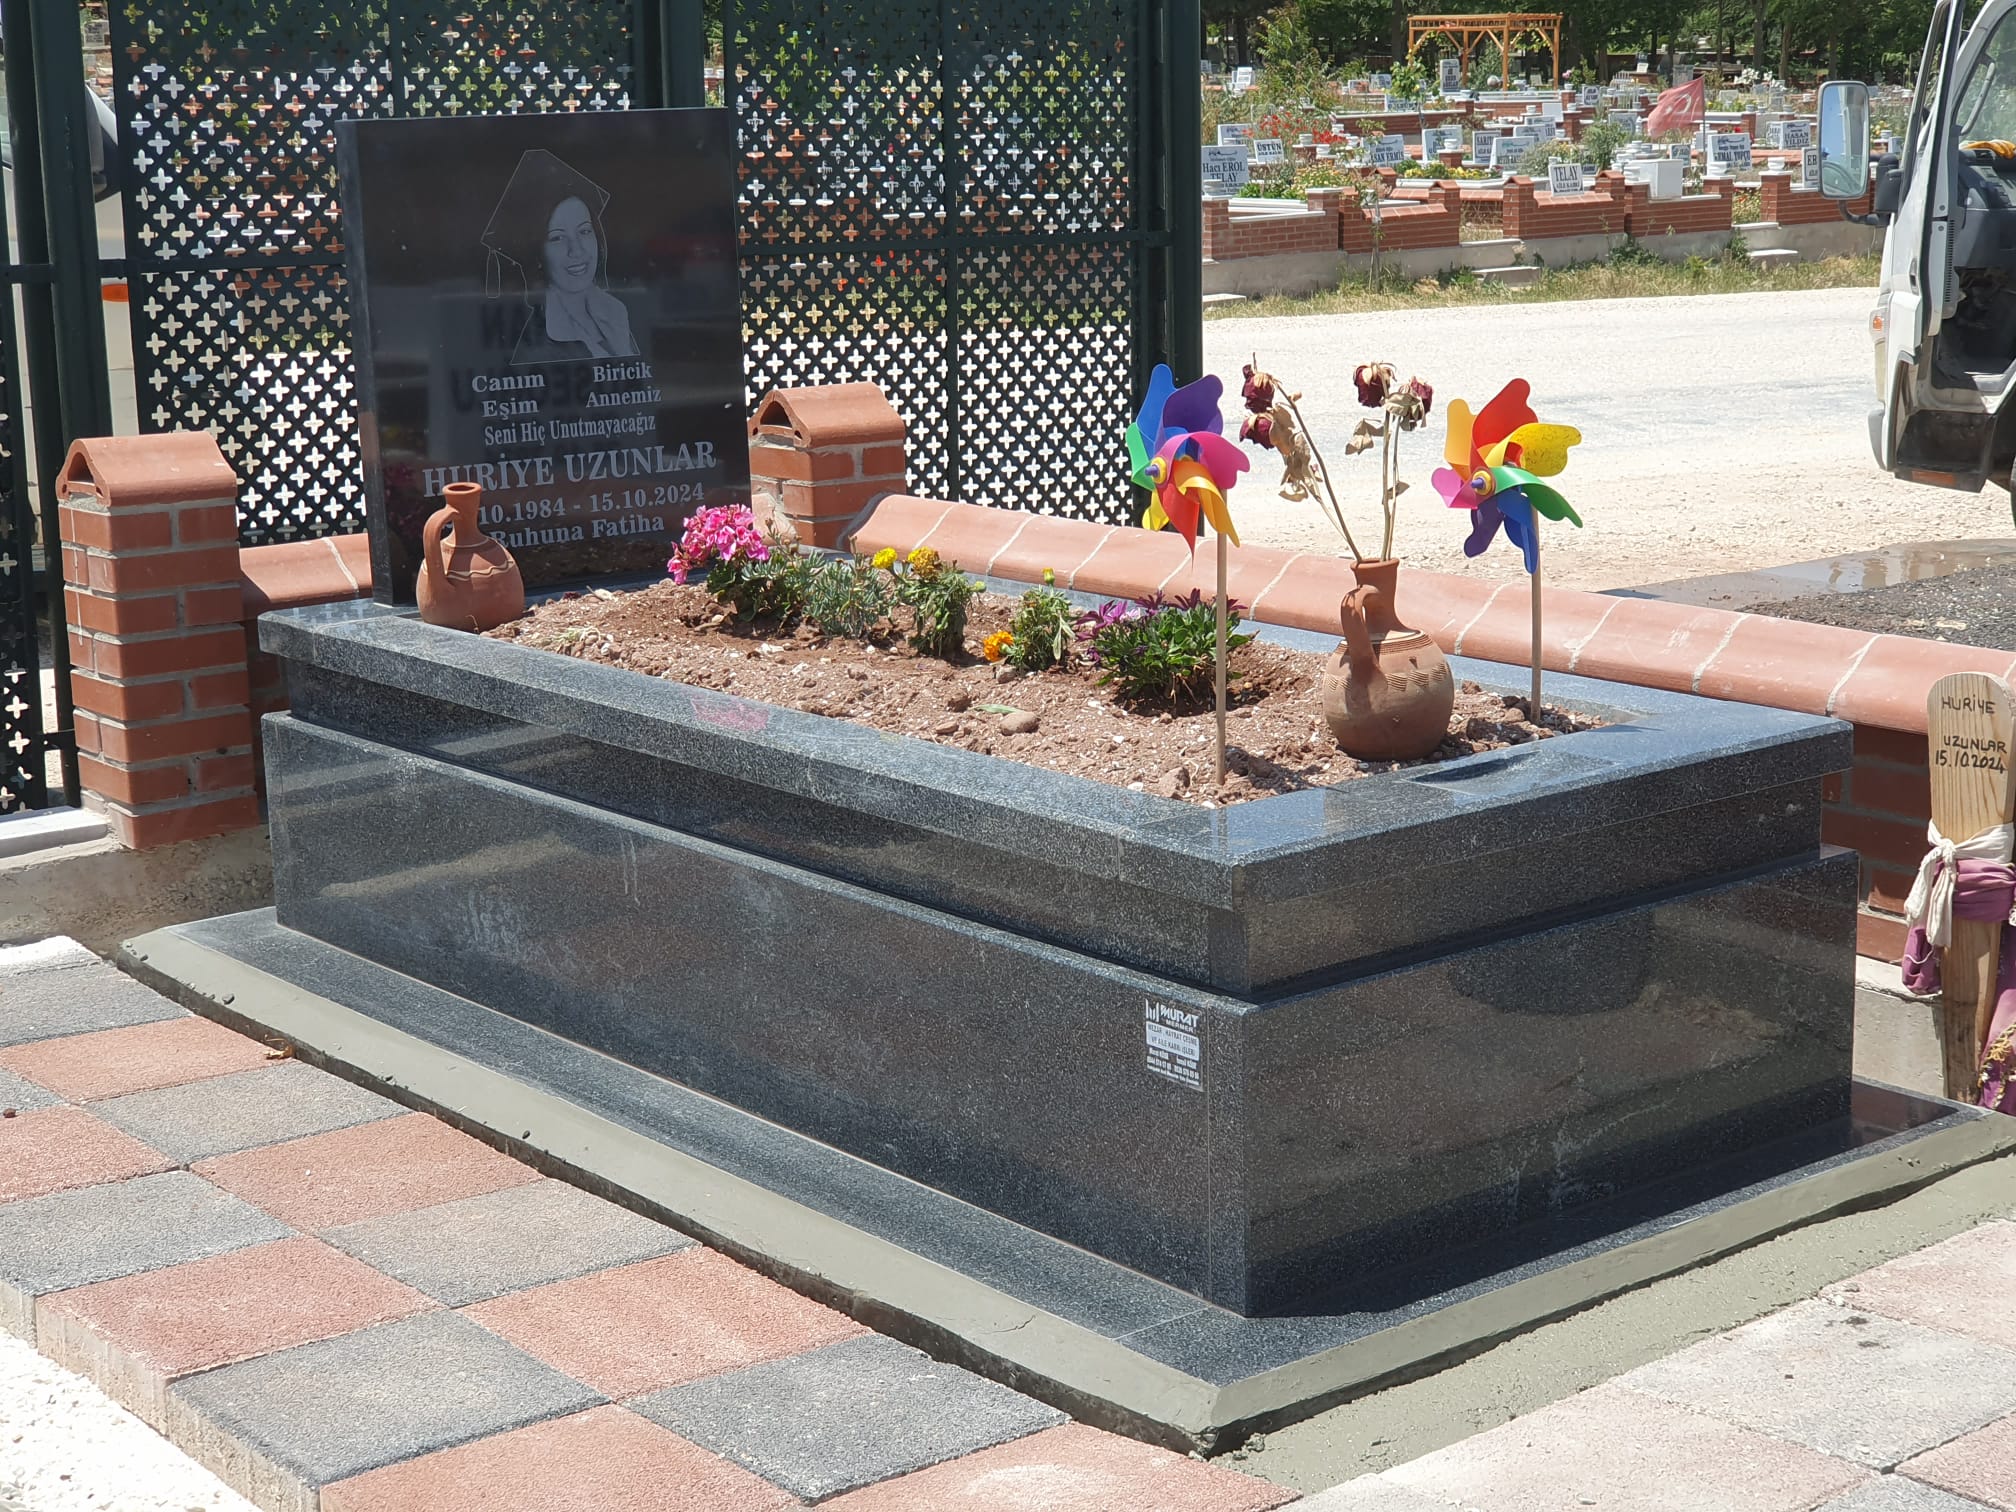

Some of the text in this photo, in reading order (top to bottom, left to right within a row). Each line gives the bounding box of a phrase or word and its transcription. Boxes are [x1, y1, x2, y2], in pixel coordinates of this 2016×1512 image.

[1222, 161, 1246, 172] EROL
[1553, 165, 1578, 181] TELAY
[471, 373, 545, 393] Canım
[593, 364, 652, 383] Biricik
[586, 387, 662, 408] Annemiz
[481, 399, 539, 421] Eşim
[484, 413, 656, 446] Seni Hiç Unutmayacağız
[422, 441, 717, 498] HURİYE UZUNLAR
[589, 483, 705, 513] 15.10.2024
[490, 514, 665, 549] Ruhuna Fatiha
[1943, 735, 2007, 754] UZUNLAR
[1160, 1004, 1199, 1028] MURAT
